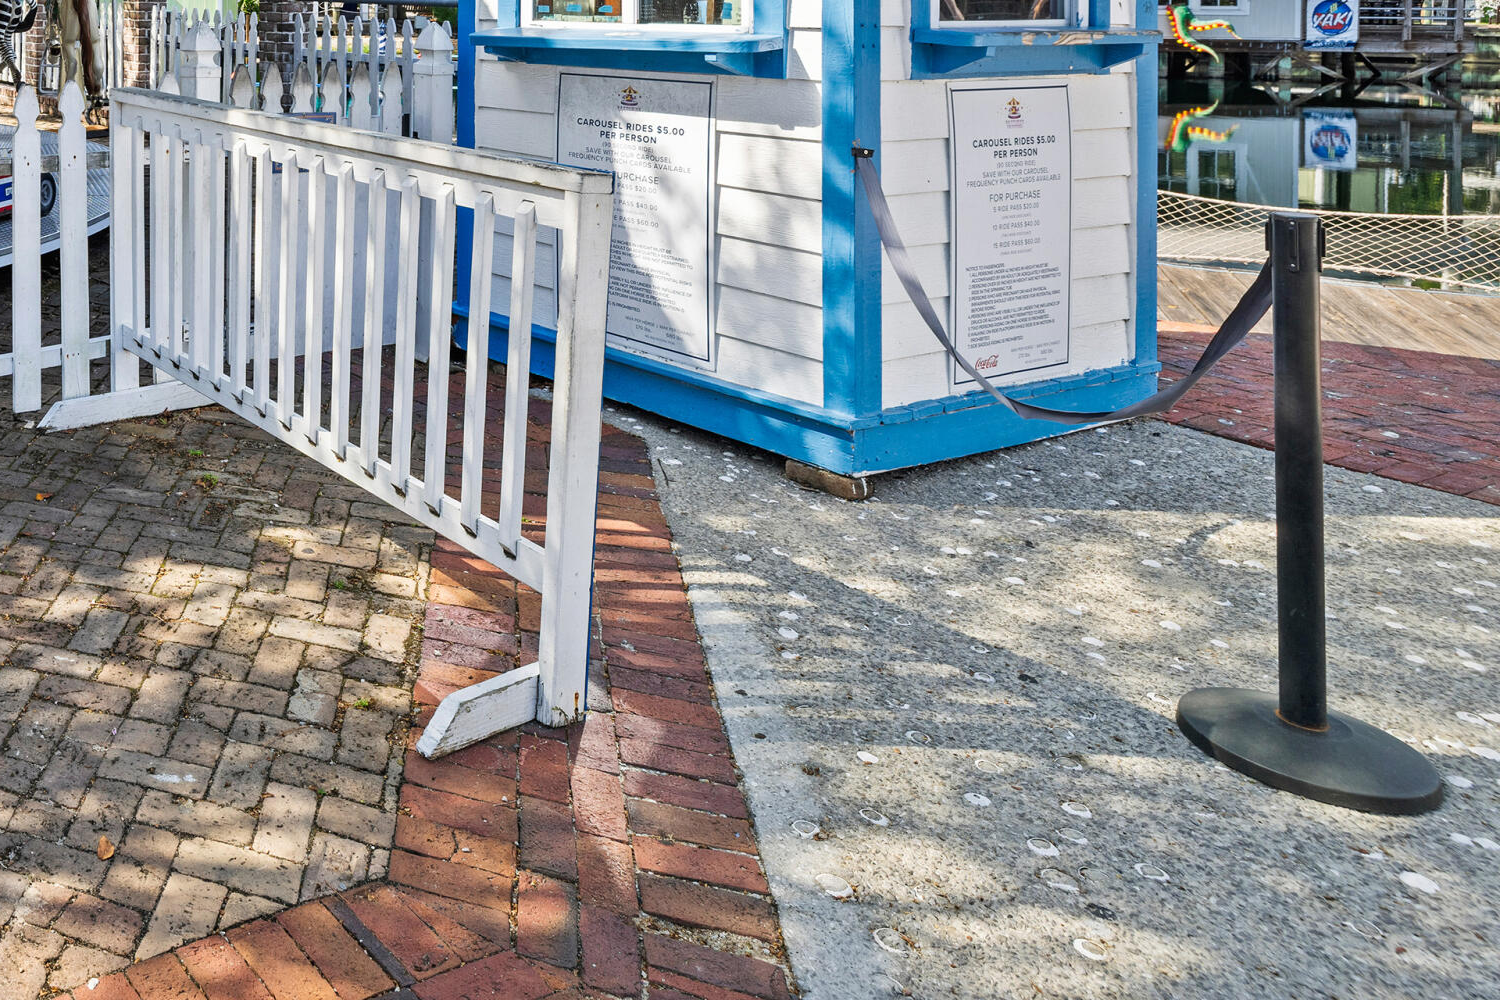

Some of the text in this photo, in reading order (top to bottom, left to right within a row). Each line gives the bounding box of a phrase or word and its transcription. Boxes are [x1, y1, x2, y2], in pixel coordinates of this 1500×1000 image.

[1313, 12, 1353, 28] YAKI
[577, 117, 685, 136] CAROUSEL RIDES $5.00
[600, 131, 656, 144] PER PERSON
[973, 135, 1055, 148] CAROUSEL RIDES $5.00
[636, 153, 671, 163] CAROUSEL
[994, 148, 1038, 158] PER PERSON
[568, 152, 691, 174] FREQUENCY PUNCH CARDS AVAILABLE
[1024, 167, 1049, 175] CAROUSEL
[617, 172, 659, 185] URCHASE
[967, 179, 998, 188] FREQUENCY
[1036, 174, 1060, 182] AVAILABLE
[989, 190, 1040, 203] FOR PURCHASE
[619, 216, 635, 224] PASS
